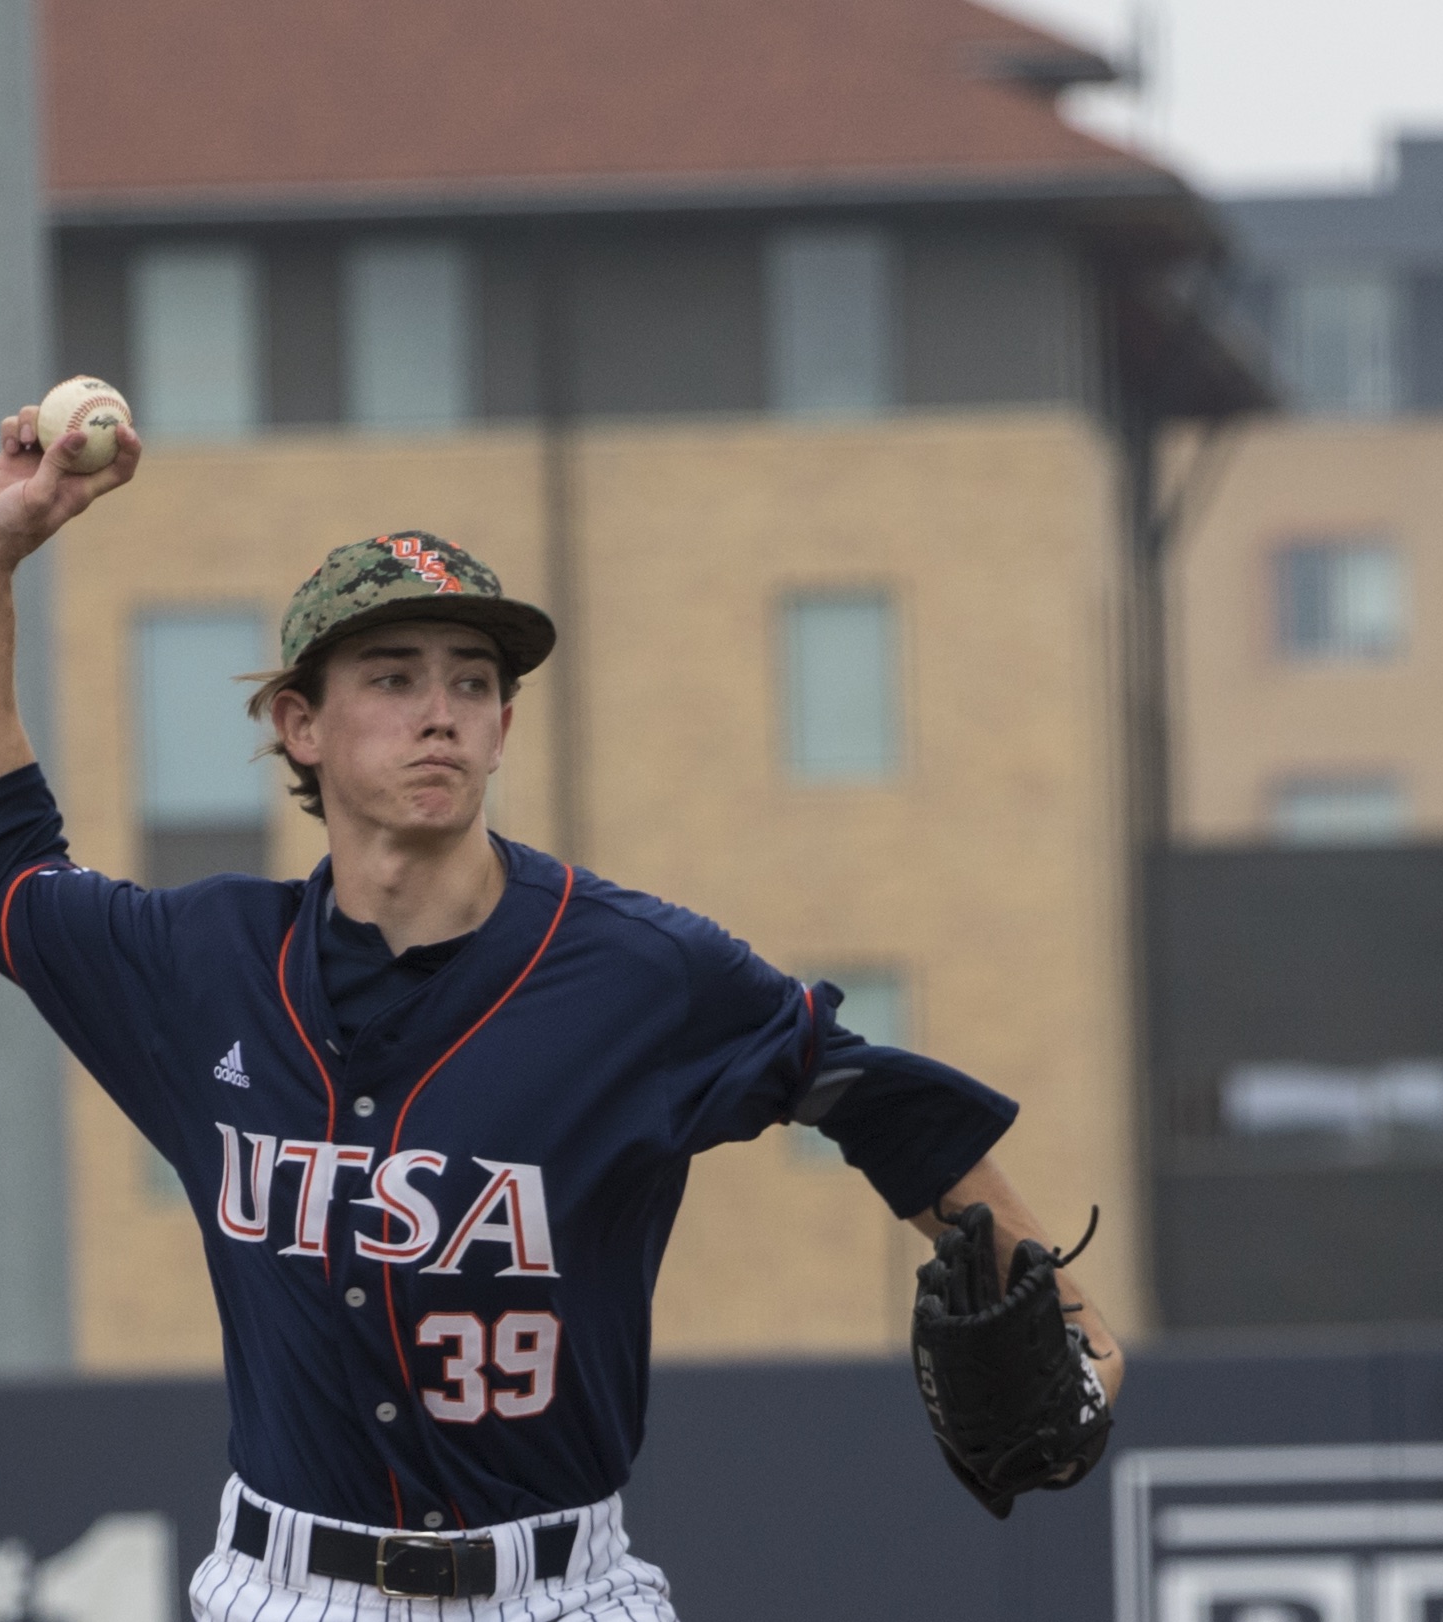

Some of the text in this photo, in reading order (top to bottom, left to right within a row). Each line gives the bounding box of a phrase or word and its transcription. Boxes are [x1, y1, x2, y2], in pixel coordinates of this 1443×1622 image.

[390, 537, 463, 594] UTSA
[213, 1065, 250, 1089] adidas
[215, 1121, 561, 1278] UTSA
[416, 1310, 561, 1424] 39
